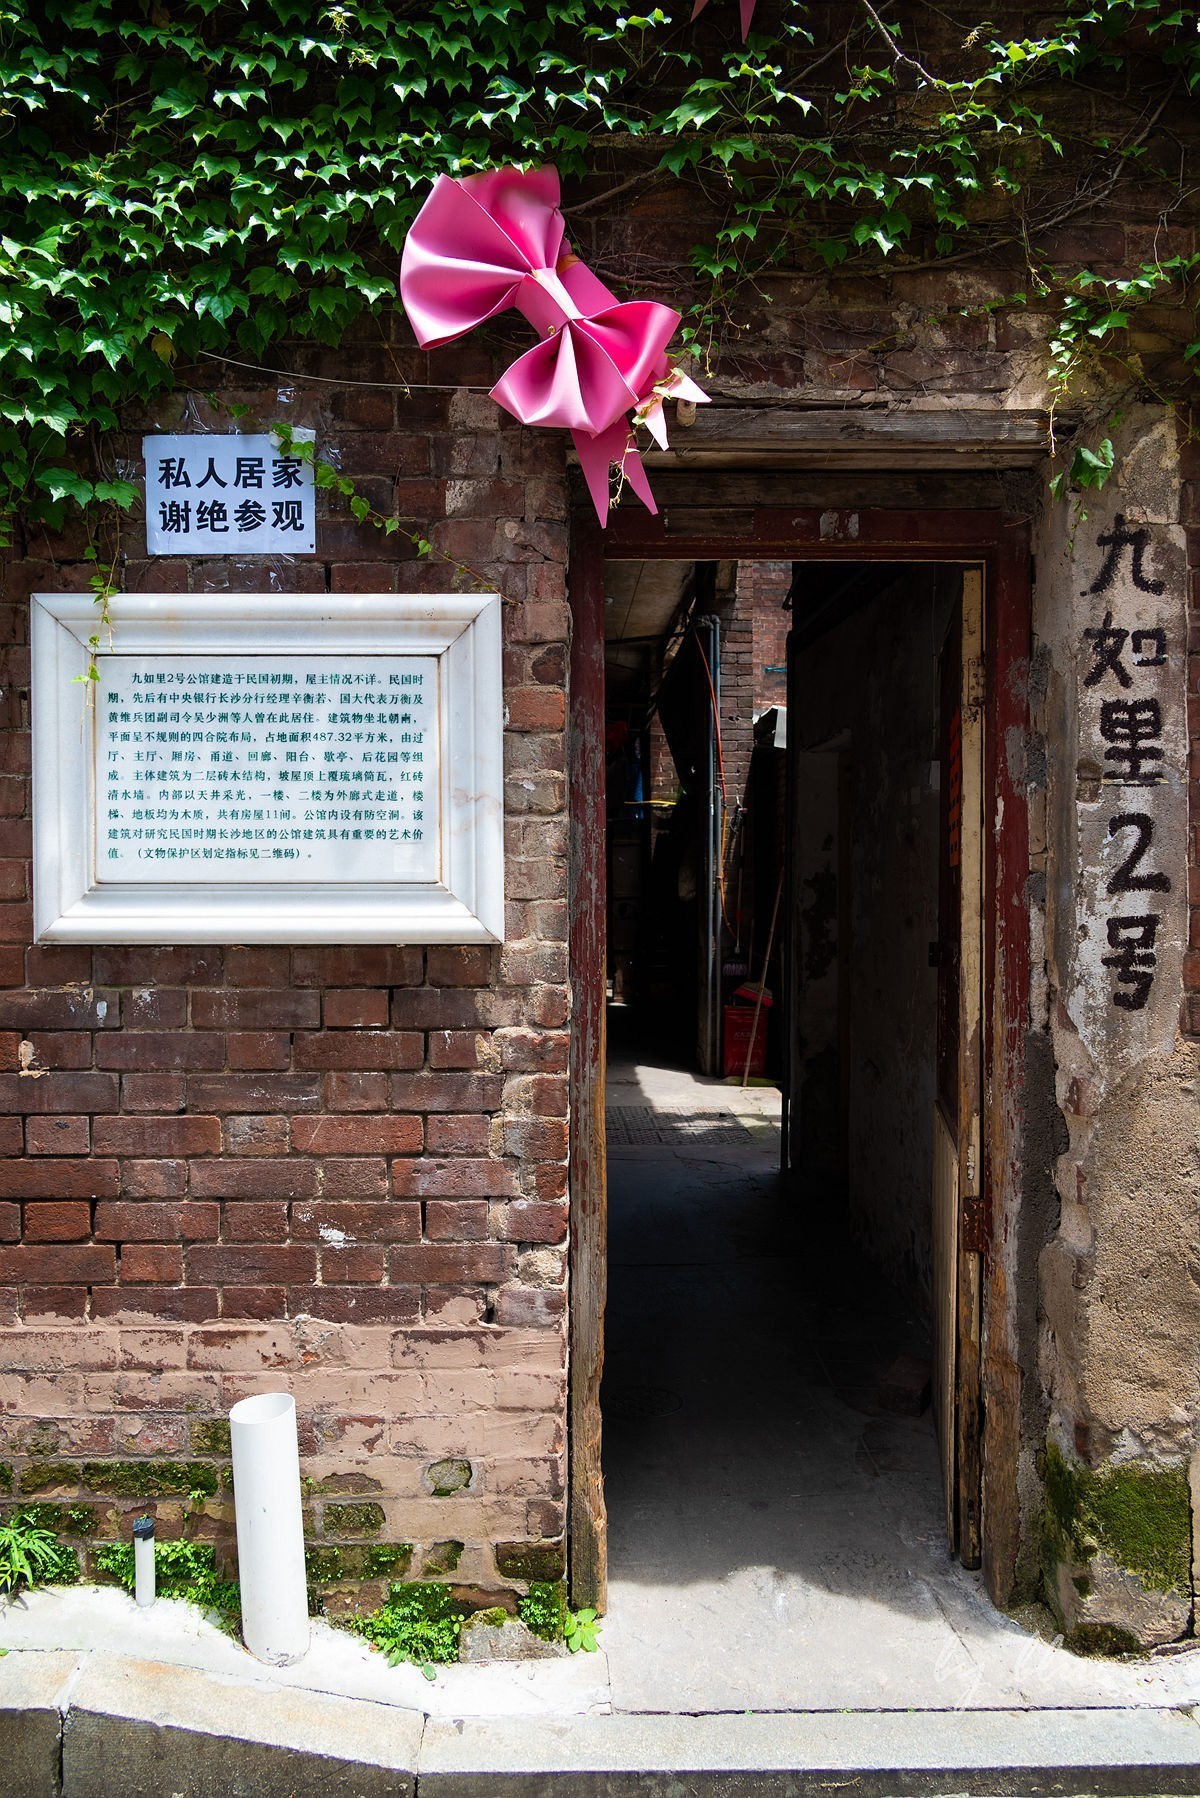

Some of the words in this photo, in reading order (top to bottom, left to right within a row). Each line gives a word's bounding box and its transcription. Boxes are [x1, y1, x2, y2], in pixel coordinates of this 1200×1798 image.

[158, 456, 304, 489] 私人居家
[158, 499, 305, 533] 谢绝参观
[1080, 512, 1170, 1010] 九如里2号
